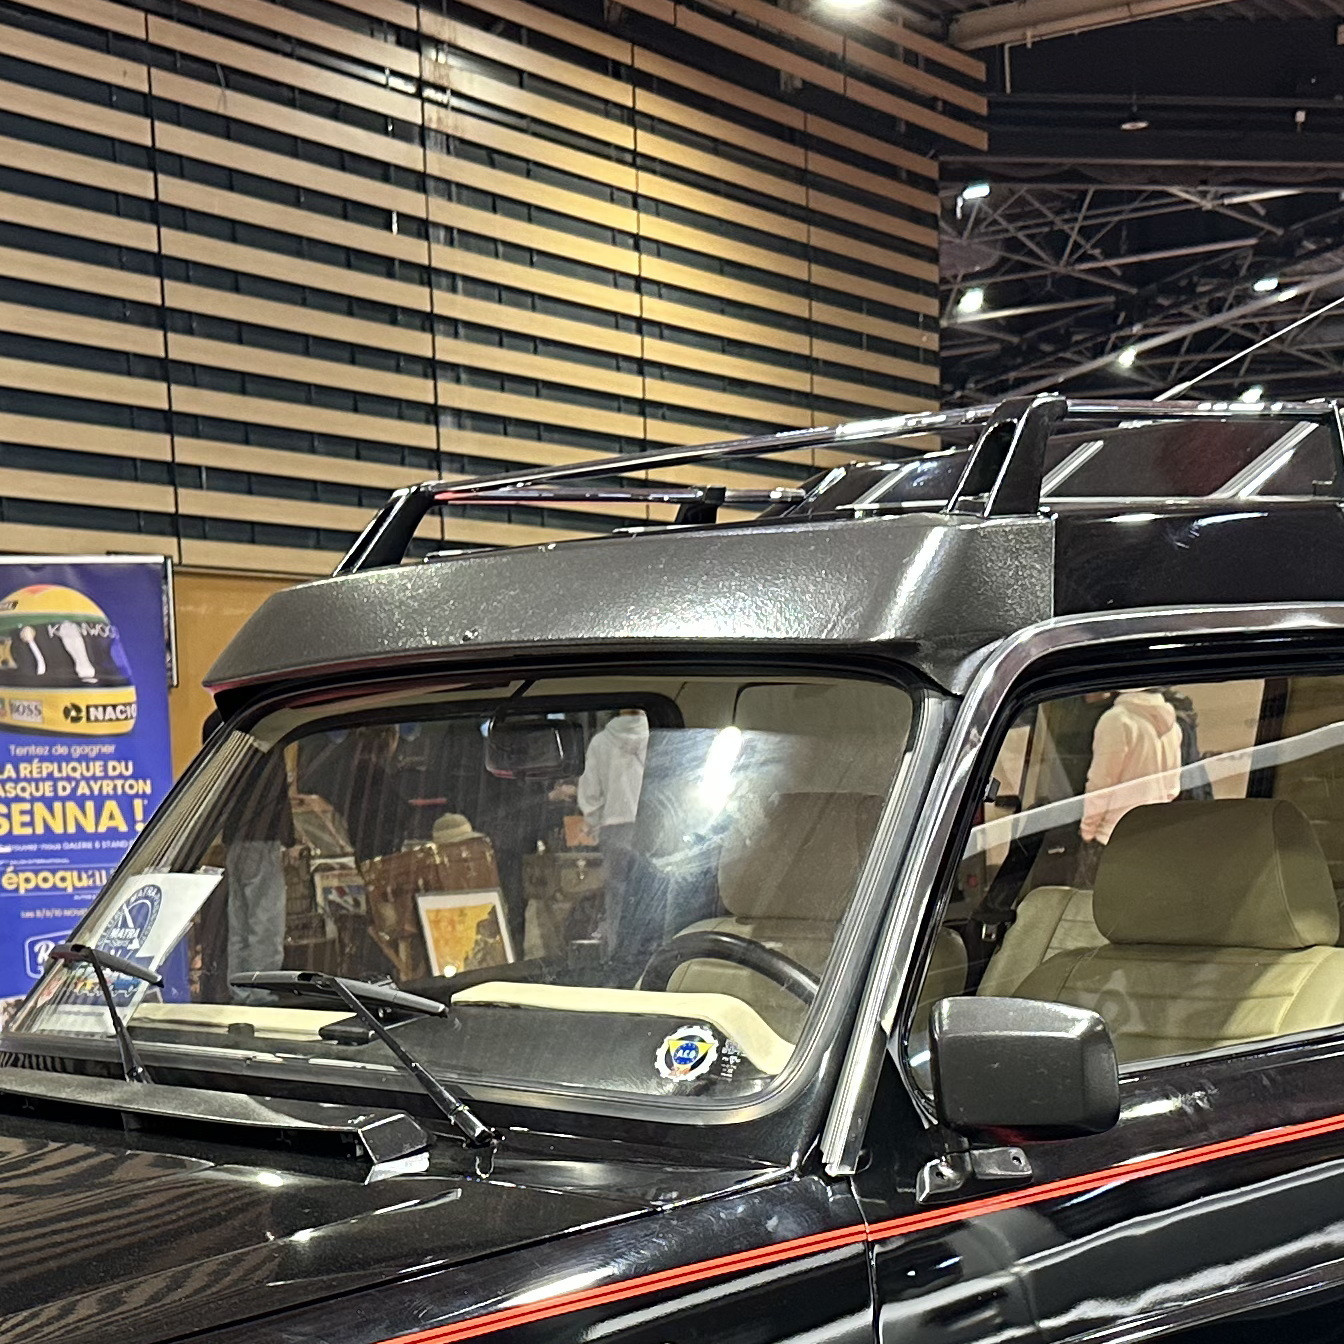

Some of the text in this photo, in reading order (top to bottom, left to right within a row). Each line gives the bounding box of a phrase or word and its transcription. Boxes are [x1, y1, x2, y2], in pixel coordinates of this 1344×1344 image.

[10, 744, 116, 757] Tentez de gagner
[19, 758, 104, 779] RÉPLIQUE
[108, 761, 133, 776] DU
[58, 779, 152, 796] D'AYRTON
